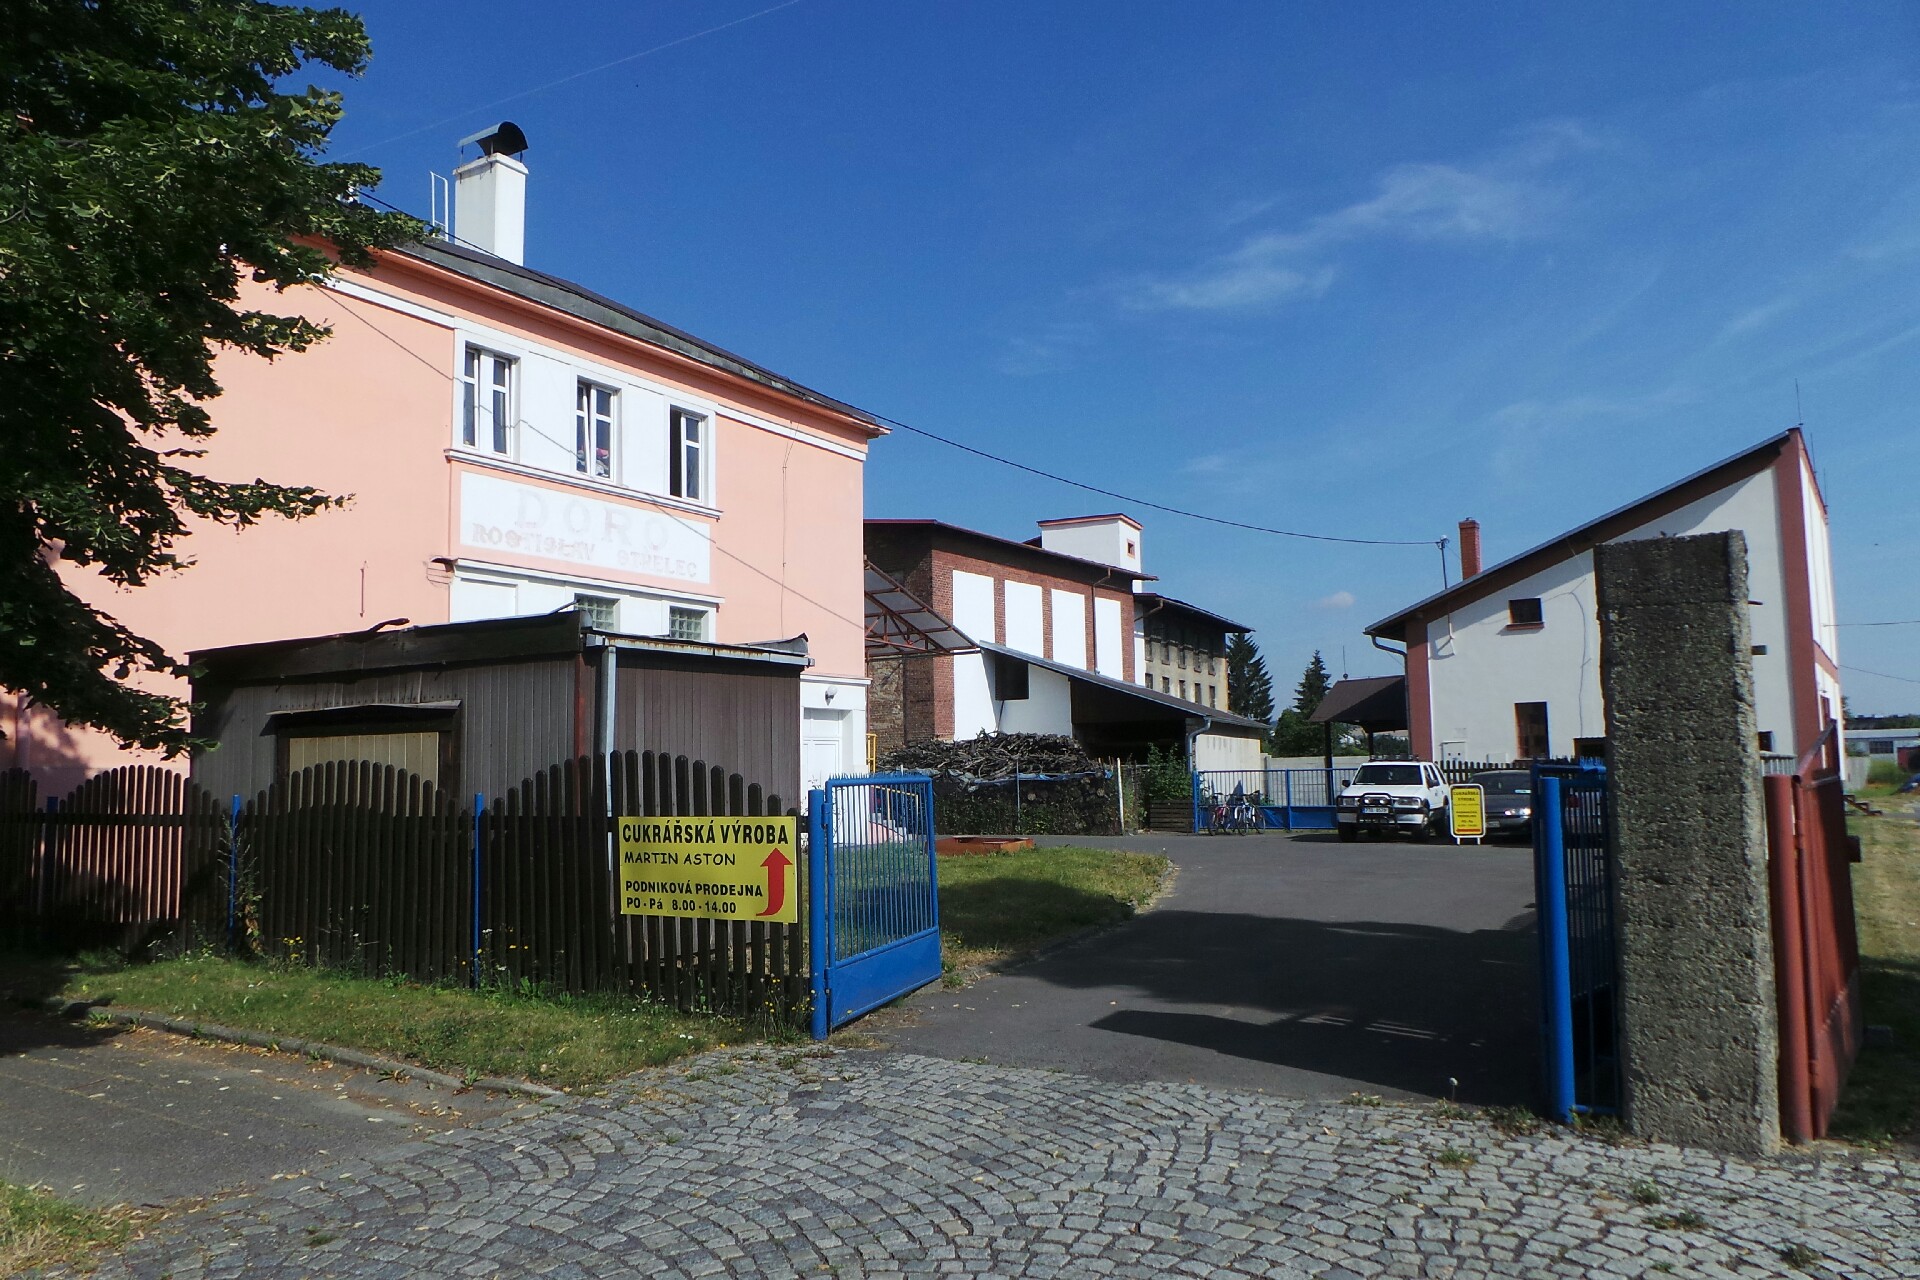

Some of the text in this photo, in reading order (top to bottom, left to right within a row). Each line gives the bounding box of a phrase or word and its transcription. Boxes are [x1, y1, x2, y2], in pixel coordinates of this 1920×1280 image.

[515, 488, 669, 550] DORO
[622, 819, 789, 845] CUKRÁŘSKÁ VÝROBA
[624, 852, 736, 866] MARTIN ASTON
[625, 880, 763, 897] PODNIKOVÁ PRODEJNA
[626, 897, 641, 909] PO
[649, 899, 663, 910] Pá
[672, 900, 696, 911] 8.00
[705, 901, 737, 914] 14.00
